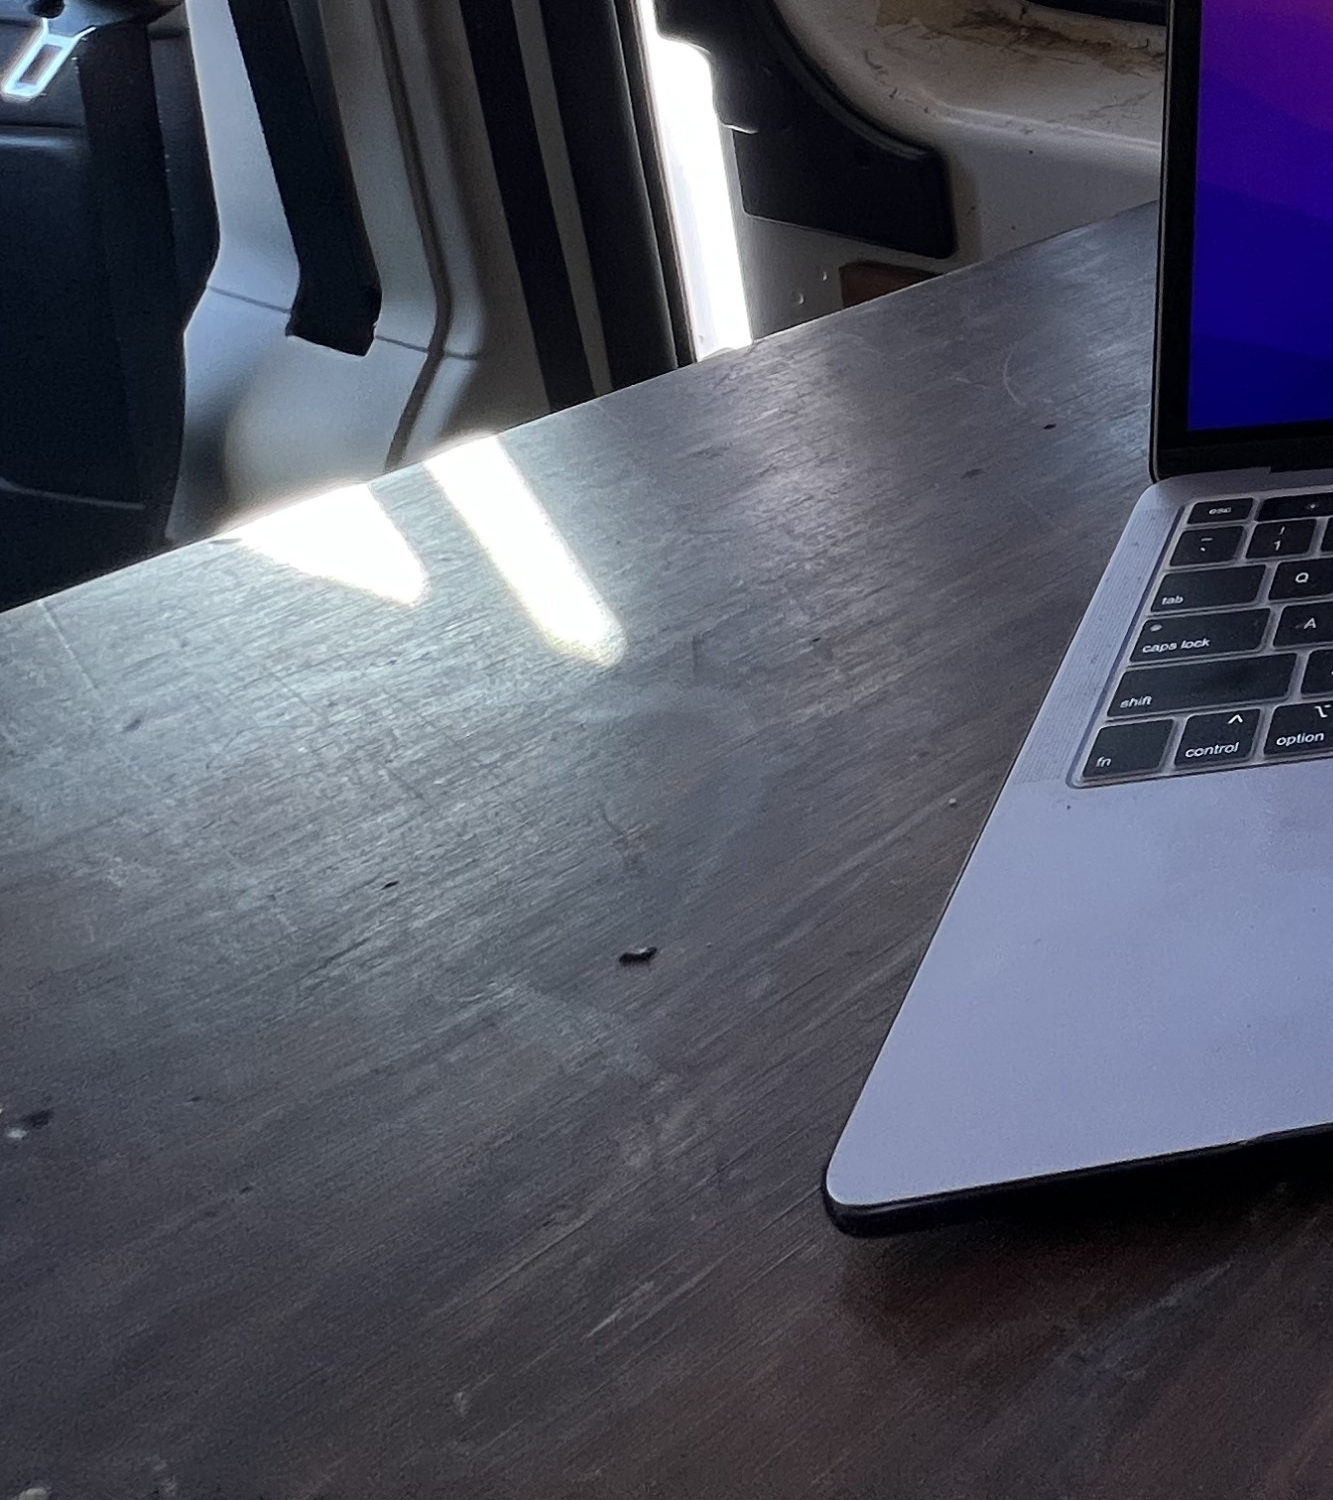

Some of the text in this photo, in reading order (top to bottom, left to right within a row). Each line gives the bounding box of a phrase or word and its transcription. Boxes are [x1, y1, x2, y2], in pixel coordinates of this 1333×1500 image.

[1273, 539, 1282, 551] 1
[1295, 572, 1309, 583] Q
[1161, 595, 1184, 605] tab
[1303, 618, 1317, 630] A
[1142, 637, 1211, 654] caps lock
[1120, 695, 1153, 709] shift
[1276, 731, 1325, 746] option
[1185, 742, 1240, 758] control
[1096, 756, 1112, 767] fn
